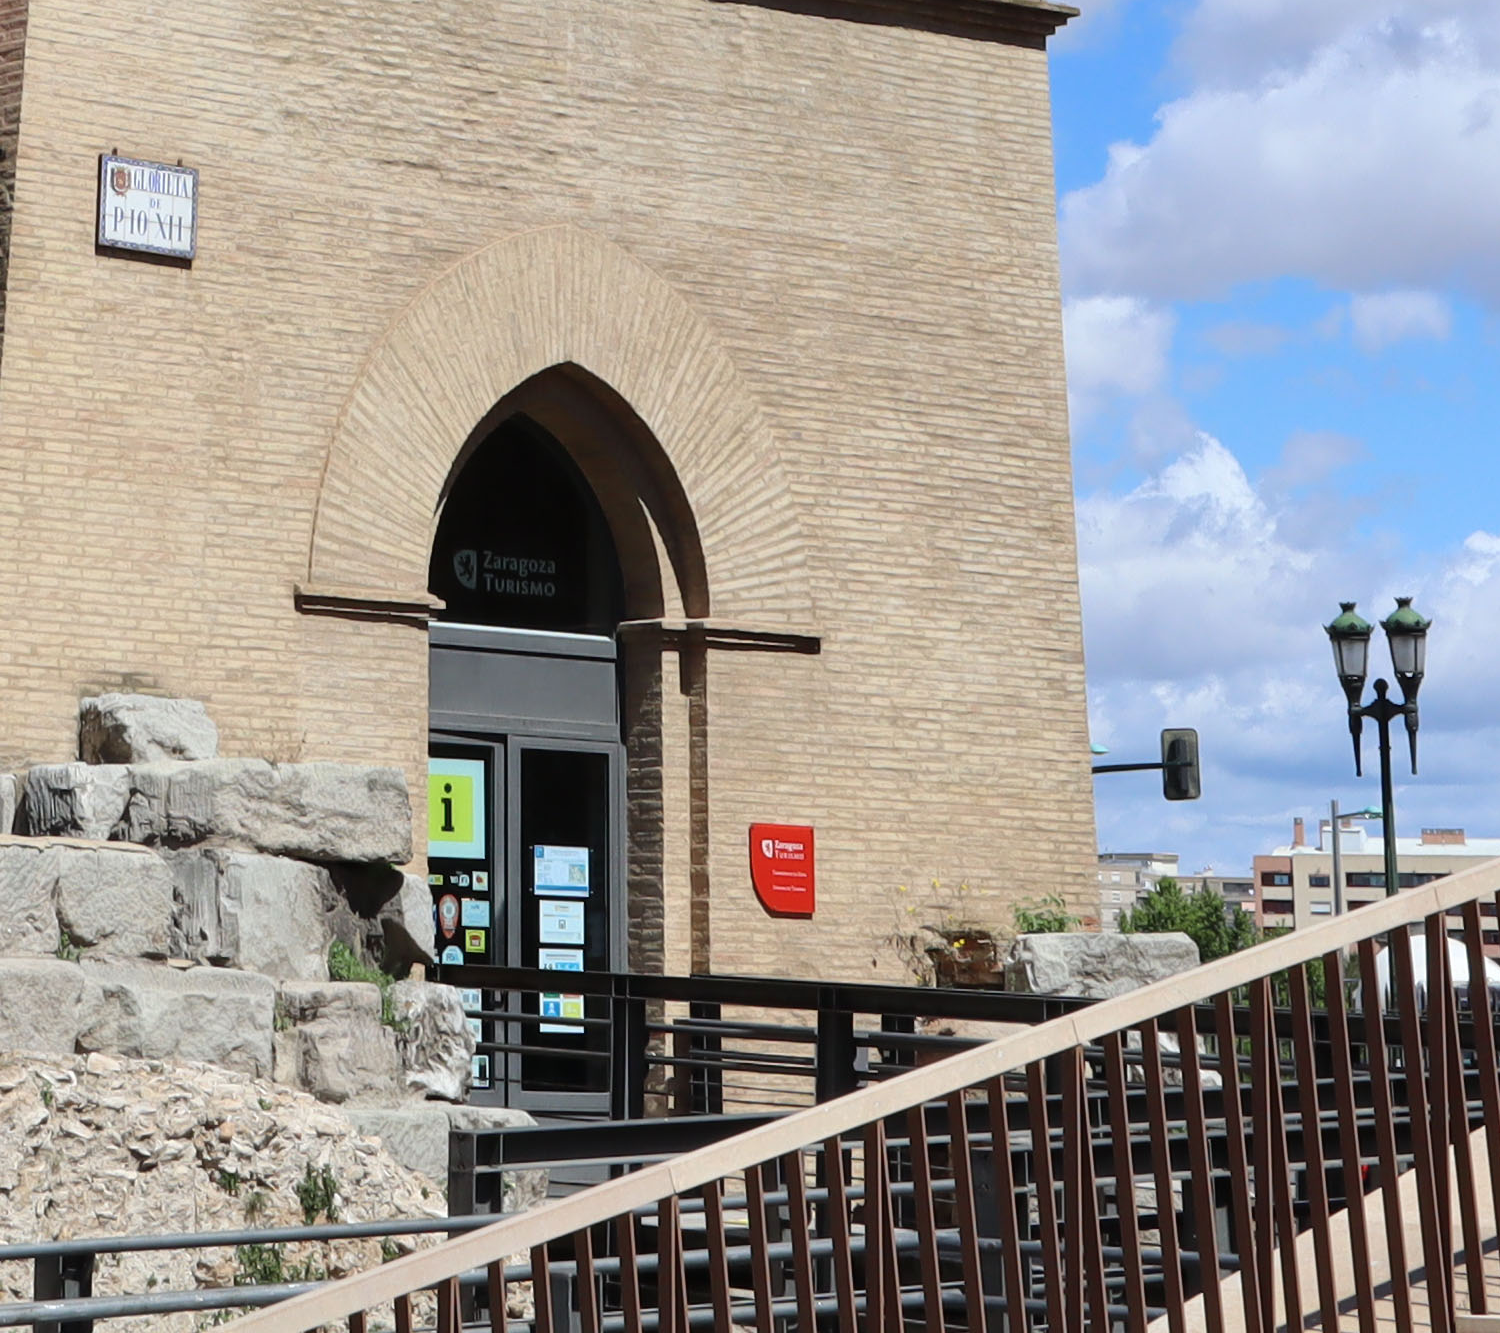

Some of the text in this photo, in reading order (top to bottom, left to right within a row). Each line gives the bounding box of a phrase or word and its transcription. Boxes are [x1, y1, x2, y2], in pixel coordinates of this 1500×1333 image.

[133, 169, 188, 198] GLORIETA
[150, 198, 161, 209] DE
[113, 206, 184, 242] PIO XII
[483, 550, 556, 577] Zaragoza
[483, 573, 556, 597] TURISMO
